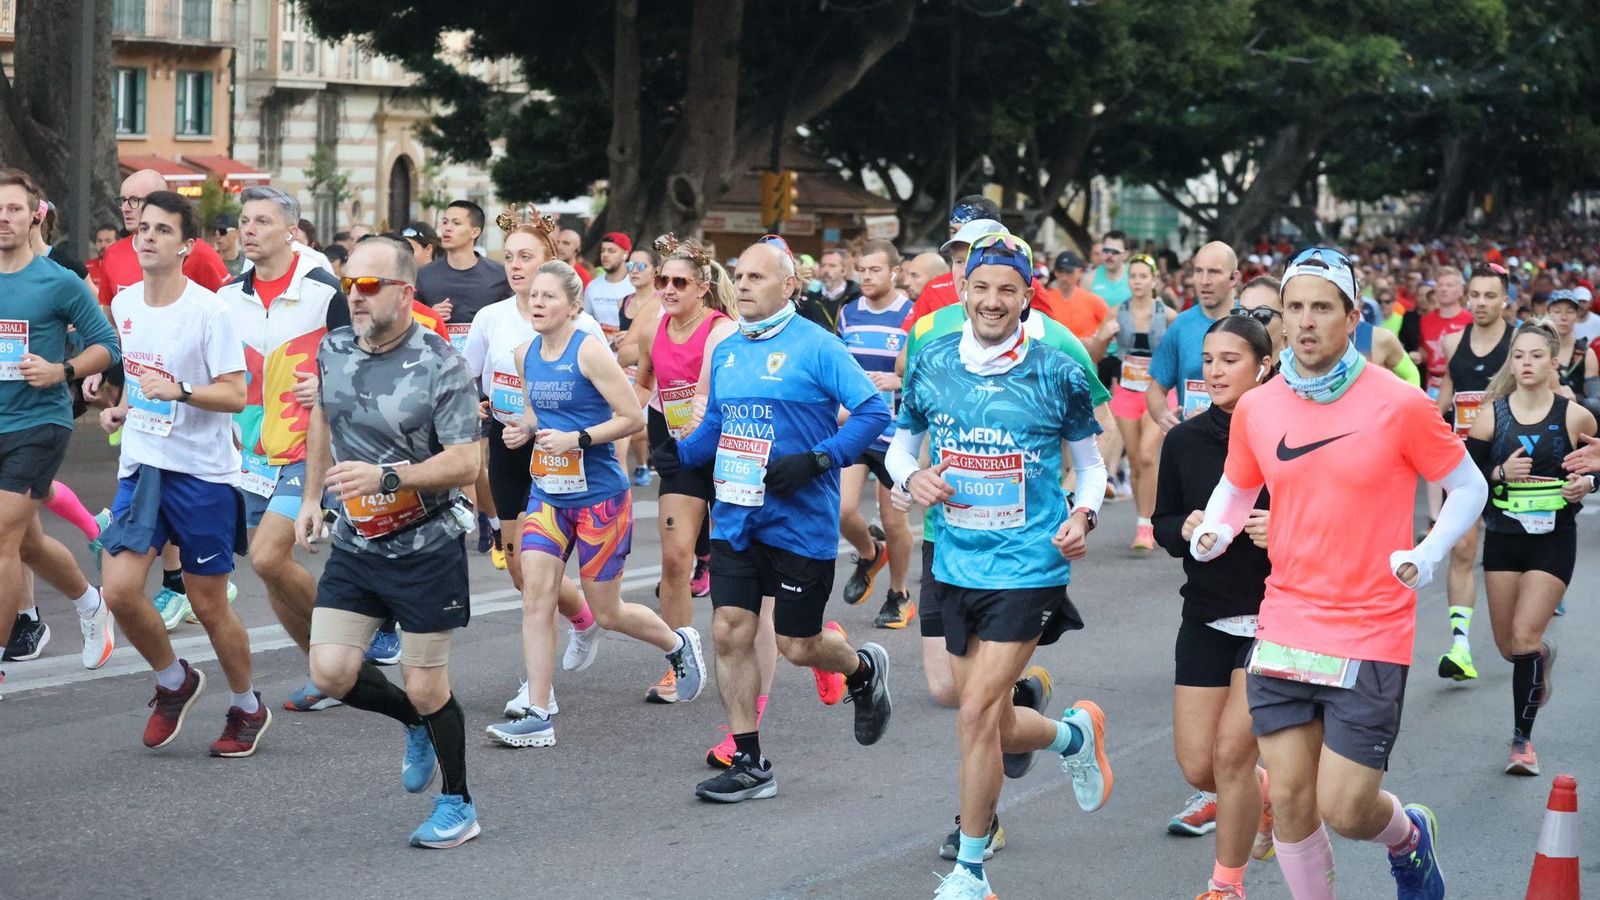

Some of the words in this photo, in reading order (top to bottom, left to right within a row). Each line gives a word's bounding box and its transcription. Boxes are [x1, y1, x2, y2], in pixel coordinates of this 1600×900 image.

[127, 384, 161, 405] 178
[752, 405, 773, 419] DE
[959, 426, 1015, 447] MEDIA
[724, 438, 763, 453] GENERALI
[538, 453, 569, 467] 14380
[721, 459, 750, 474] 12766
[959, 457, 1016, 470] GENERALI
[956, 479, 1005, 497] 16007
